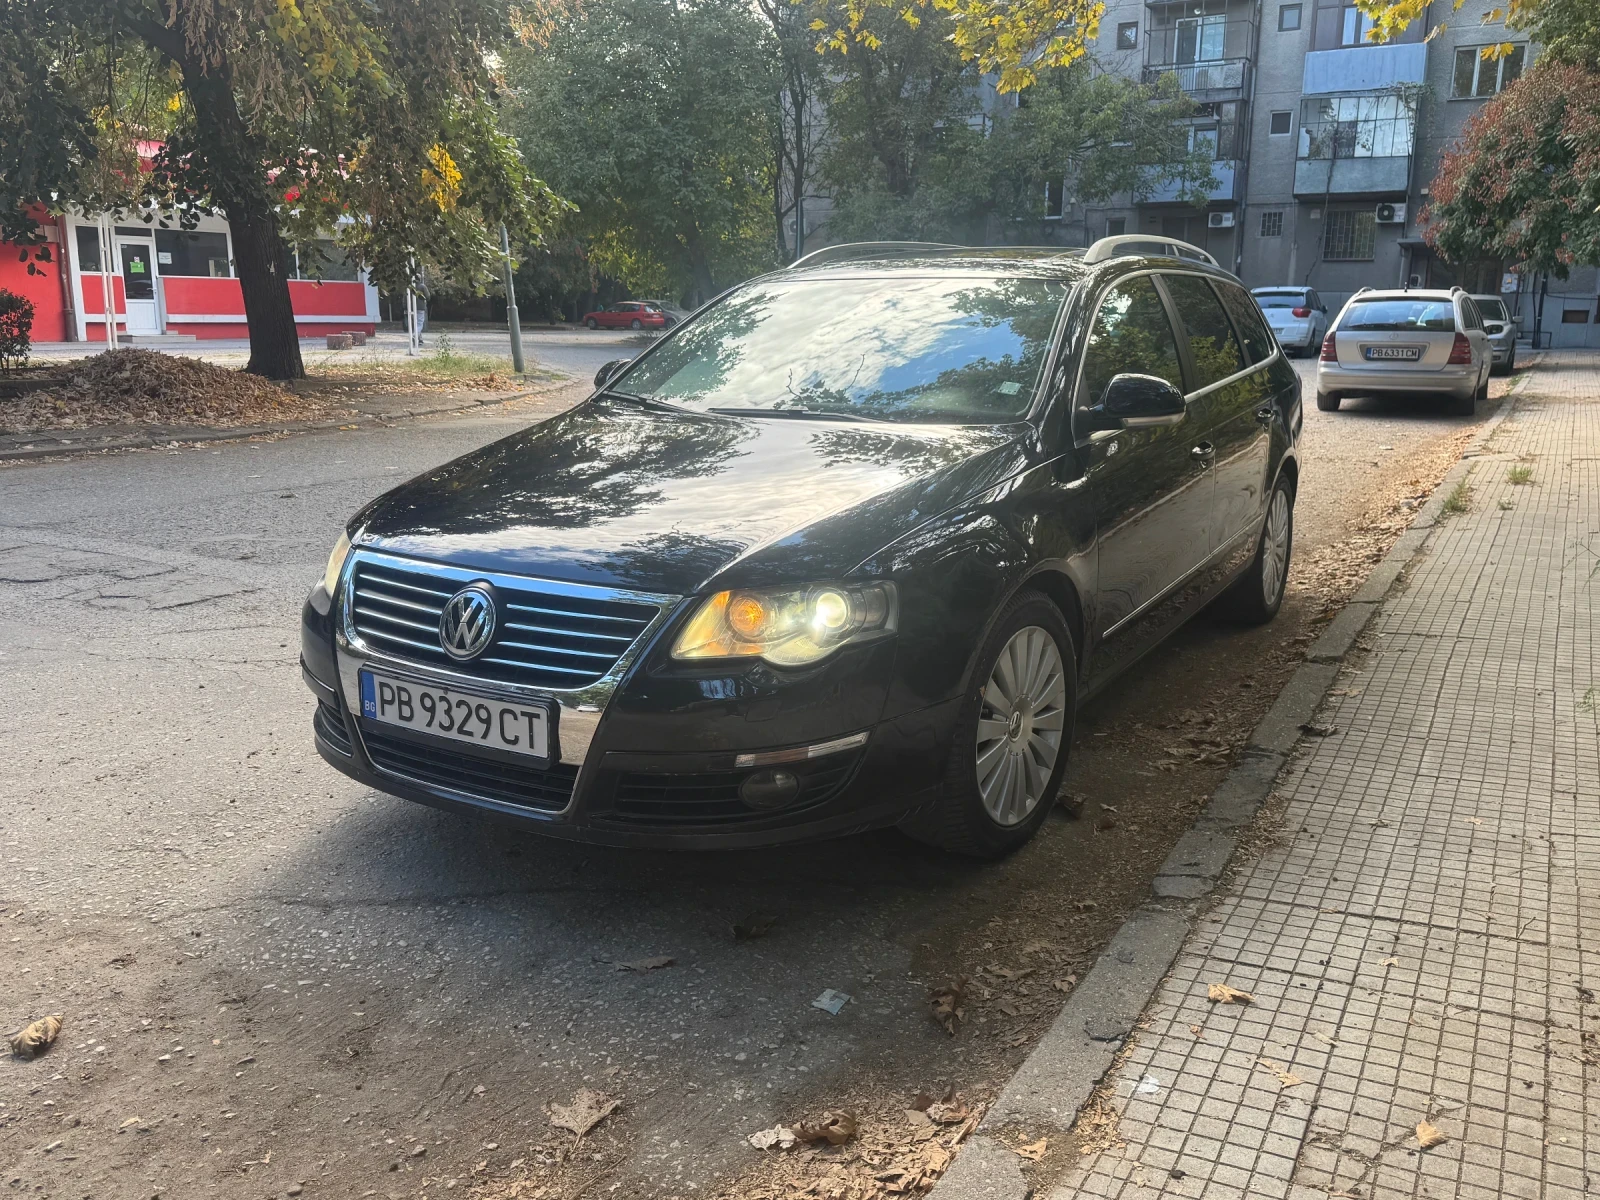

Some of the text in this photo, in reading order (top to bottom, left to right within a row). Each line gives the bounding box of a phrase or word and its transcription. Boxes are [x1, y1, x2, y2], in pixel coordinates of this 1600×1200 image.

[364, 700, 376, 713] BG
[378, 680, 541, 750] PB 9329 CT
